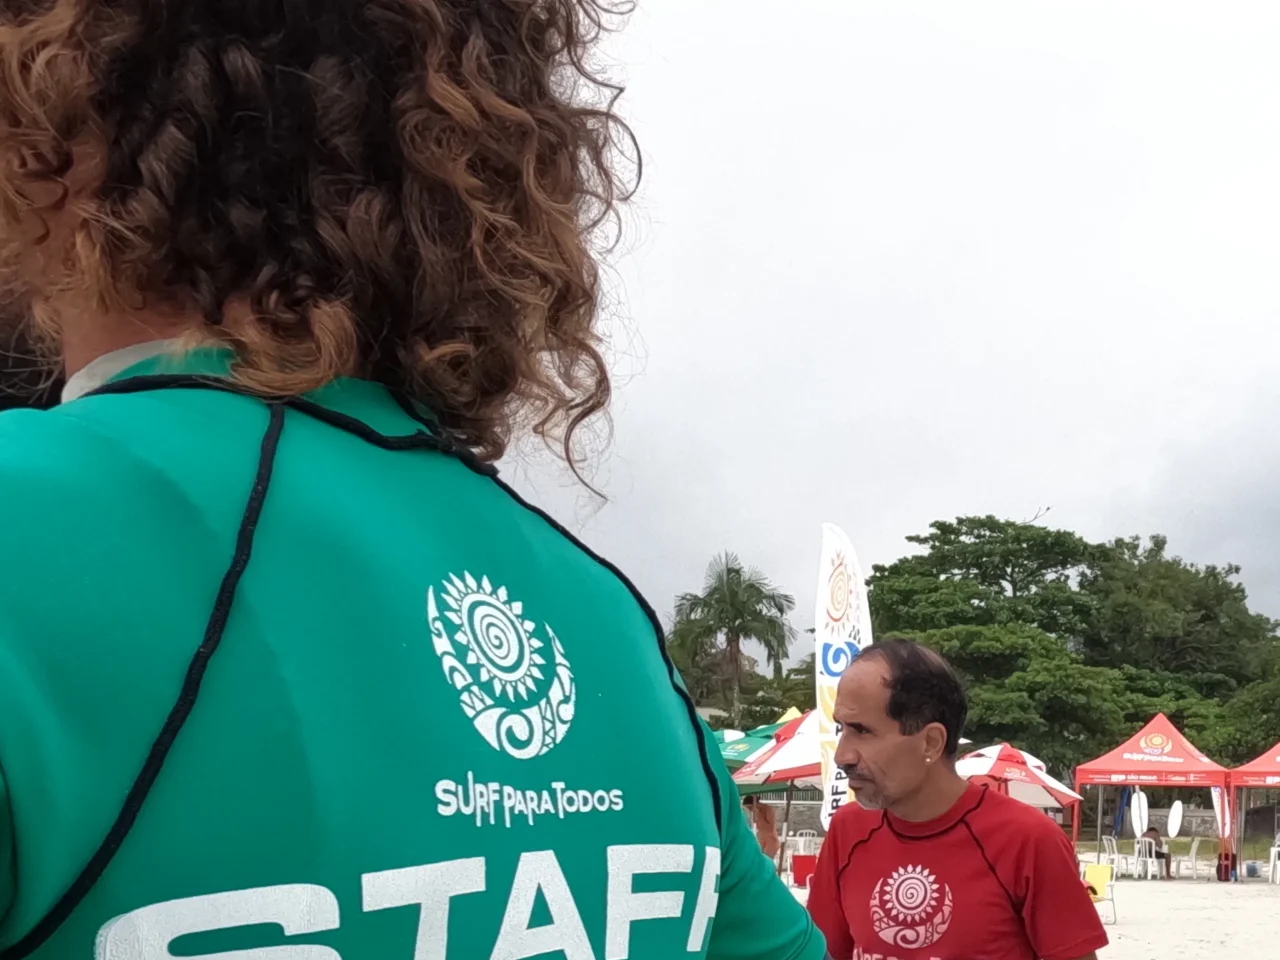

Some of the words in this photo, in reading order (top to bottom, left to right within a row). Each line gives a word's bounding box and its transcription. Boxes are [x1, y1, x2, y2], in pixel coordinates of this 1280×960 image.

[434, 770, 500, 827] SURF
[502, 785, 555, 828] PARA
[551, 781, 624, 819] TODOS
